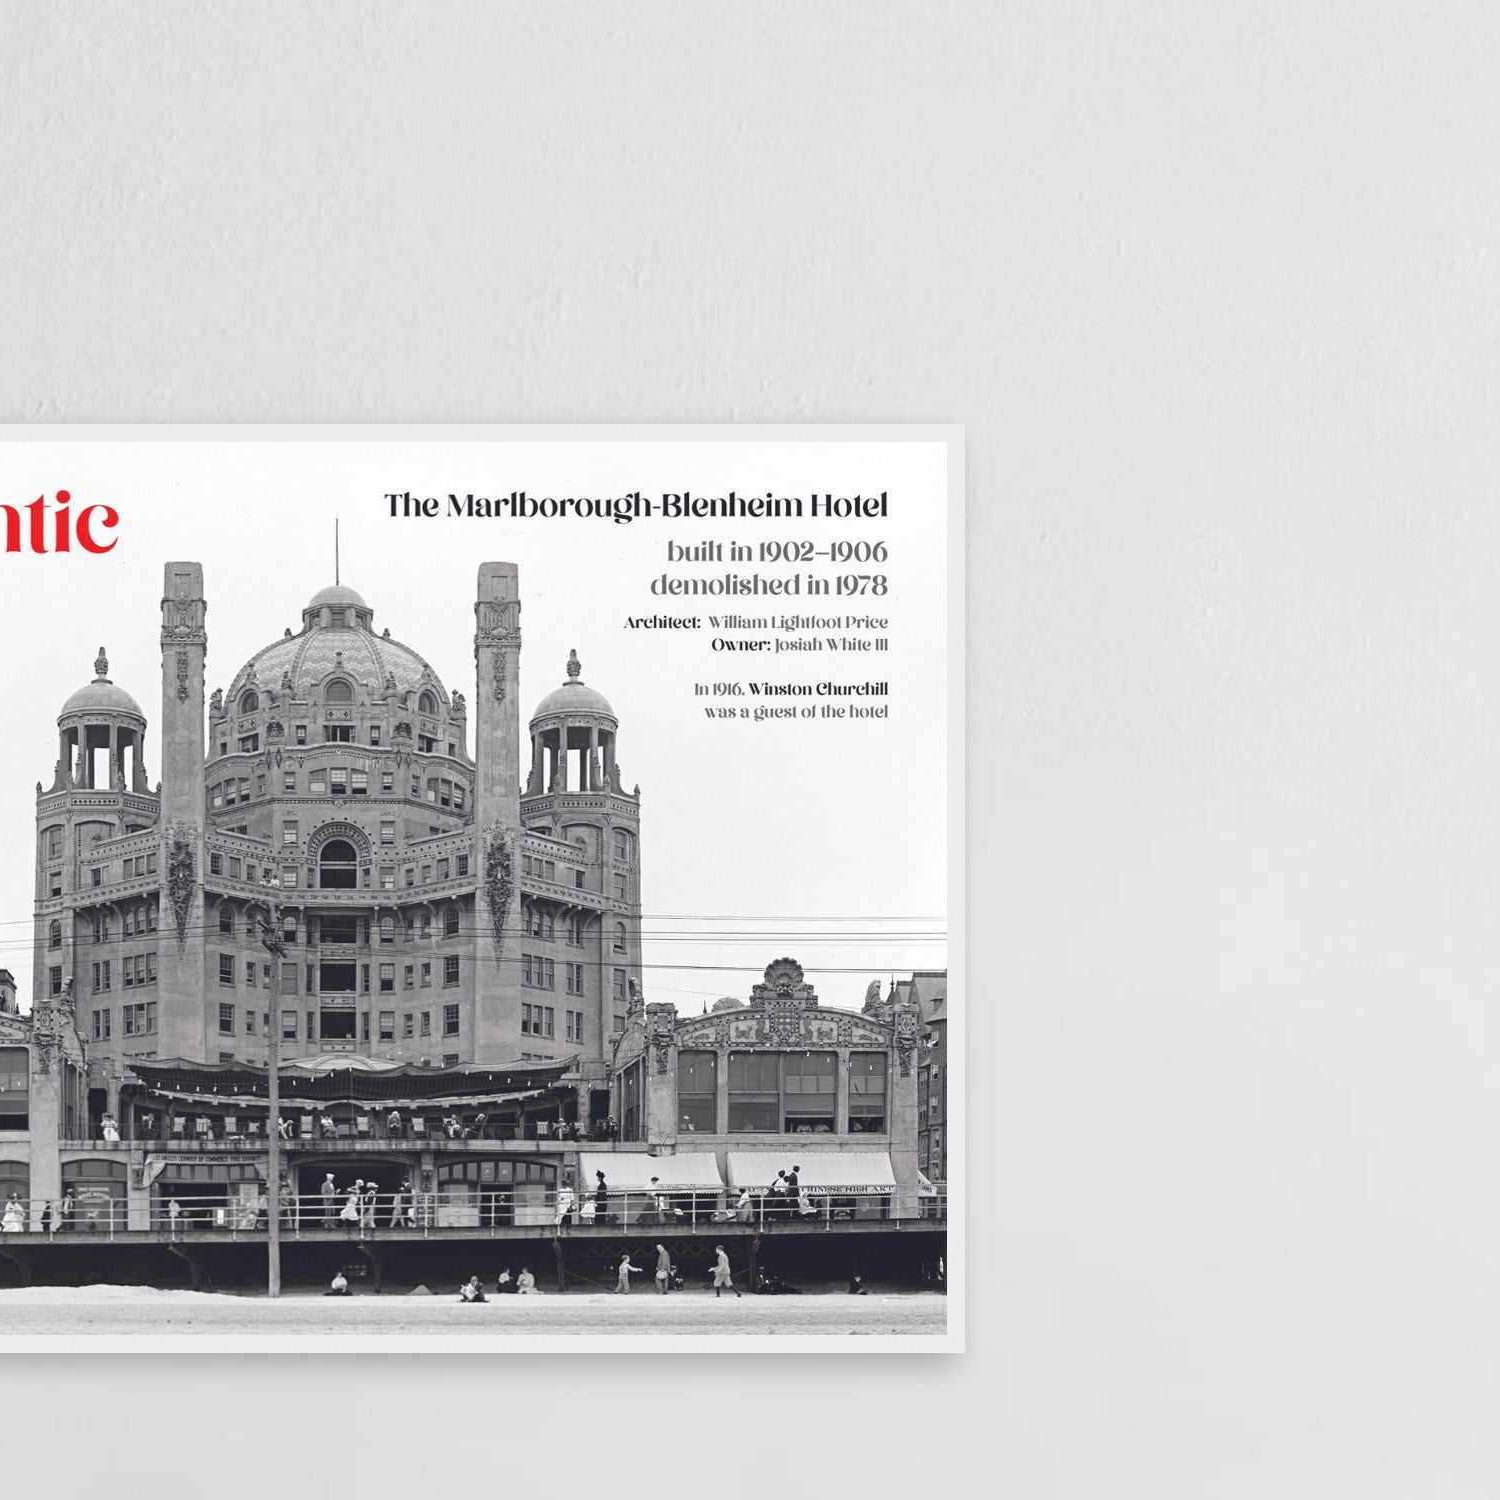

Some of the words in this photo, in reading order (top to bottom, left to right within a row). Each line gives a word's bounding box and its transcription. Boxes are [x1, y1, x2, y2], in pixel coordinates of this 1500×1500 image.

[384, 491, 440, 517] The
[447, 491, 802, 524] Marlborough-Blenheim
[811, 491, 888, 517] Hotel
[668, 540, 723, 562] built
[731, 541, 752, 562] in
[651, 573, 800, 596] demolished
[808, 574, 829, 596] in
[836, 574, 888, 596] 1978
[624, 615, 701, 630] Architect:
[709, 615, 767, 630] William
[772, 615, 841, 632] Lightfoot
[846, 615, 888, 630] Price
[712, 637, 771, 652] Owner:
[775, 637, 822, 654] Josiah
[826, 637, 871, 652] White
[875, 638, 888, 652] III
[695, 682, 709, 696] In
[748, 682, 812, 696] Winston
[816, 681, 888, 696] Churchill
[705, 707, 736, 719] was
[740, 707, 749, 719] a
[754, 705, 796, 722] guest
[801, 704, 816, 719] of
[821, 704, 845, 719] the
[850, 704, 888, 719] hotel
